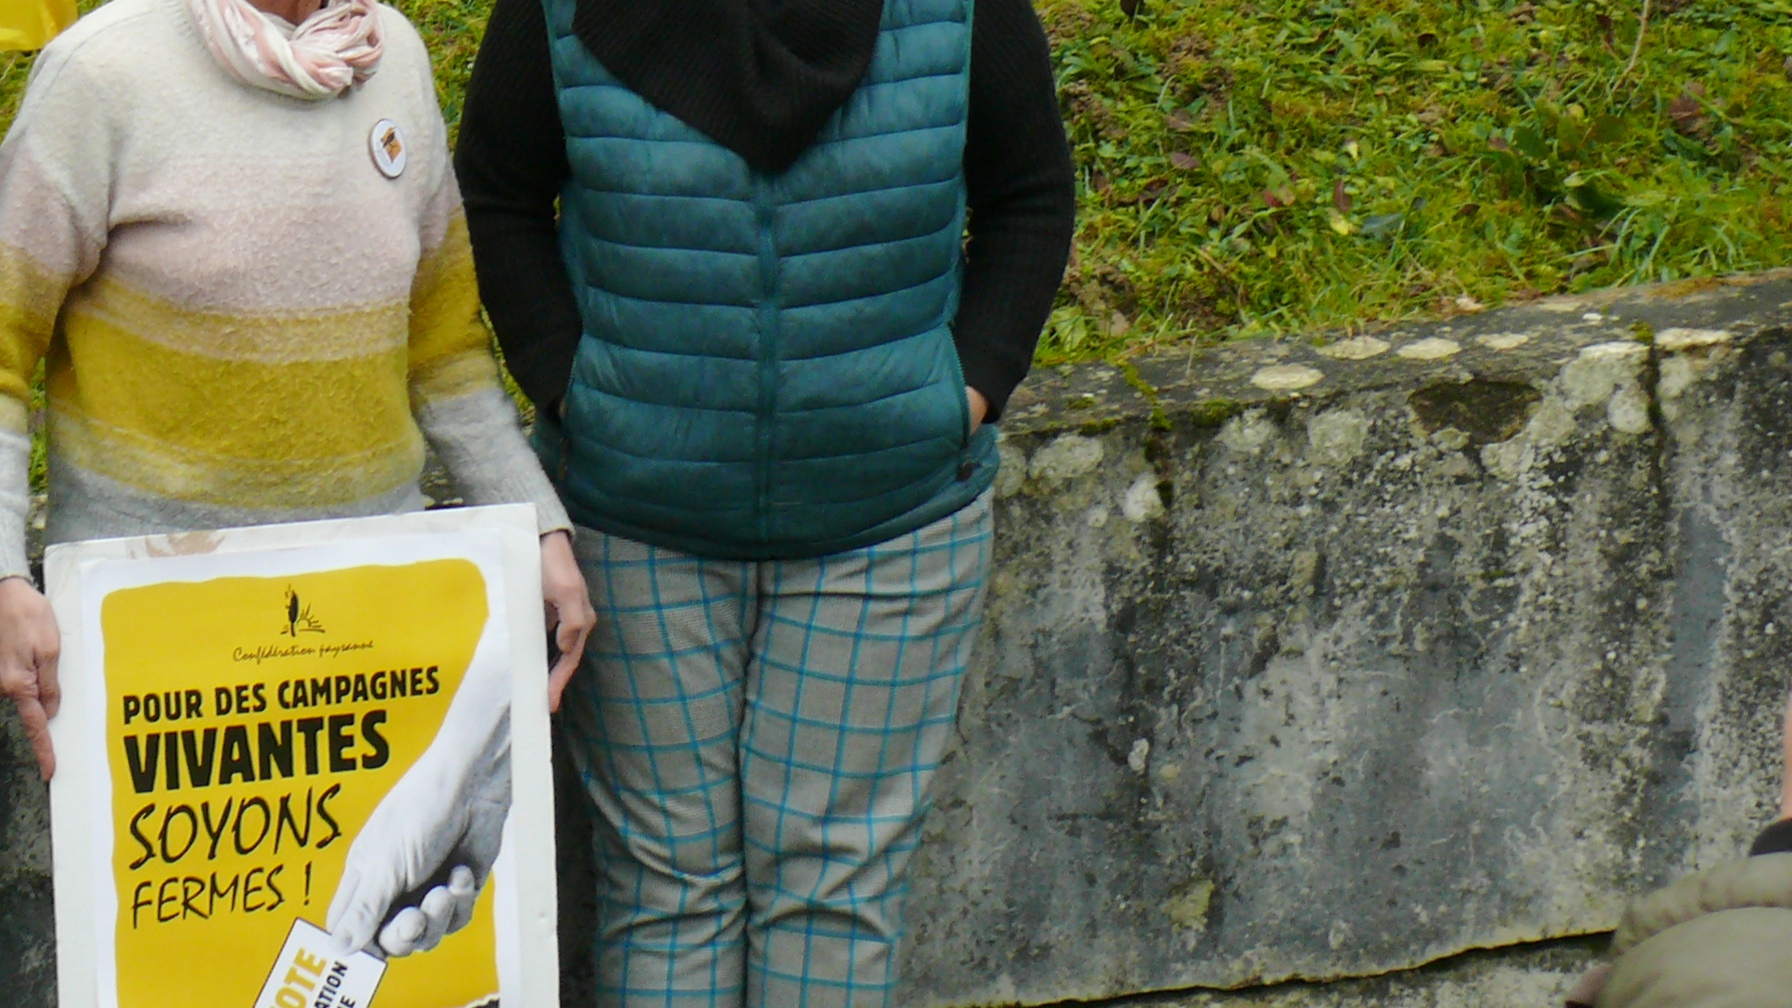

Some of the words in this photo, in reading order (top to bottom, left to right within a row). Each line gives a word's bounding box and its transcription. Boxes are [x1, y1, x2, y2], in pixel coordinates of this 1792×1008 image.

[122, 690, 203, 725] POUR
[214, 682, 267, 717] DES
[277, 665, 441, 710] CAMPAGNES
[122, 709, 391, 794] VIVANTES
[128, 783, 343, 872] SOYONS
[130, 862, 286, 930] FERMES
[270, 947, 327, 1008] OTE
